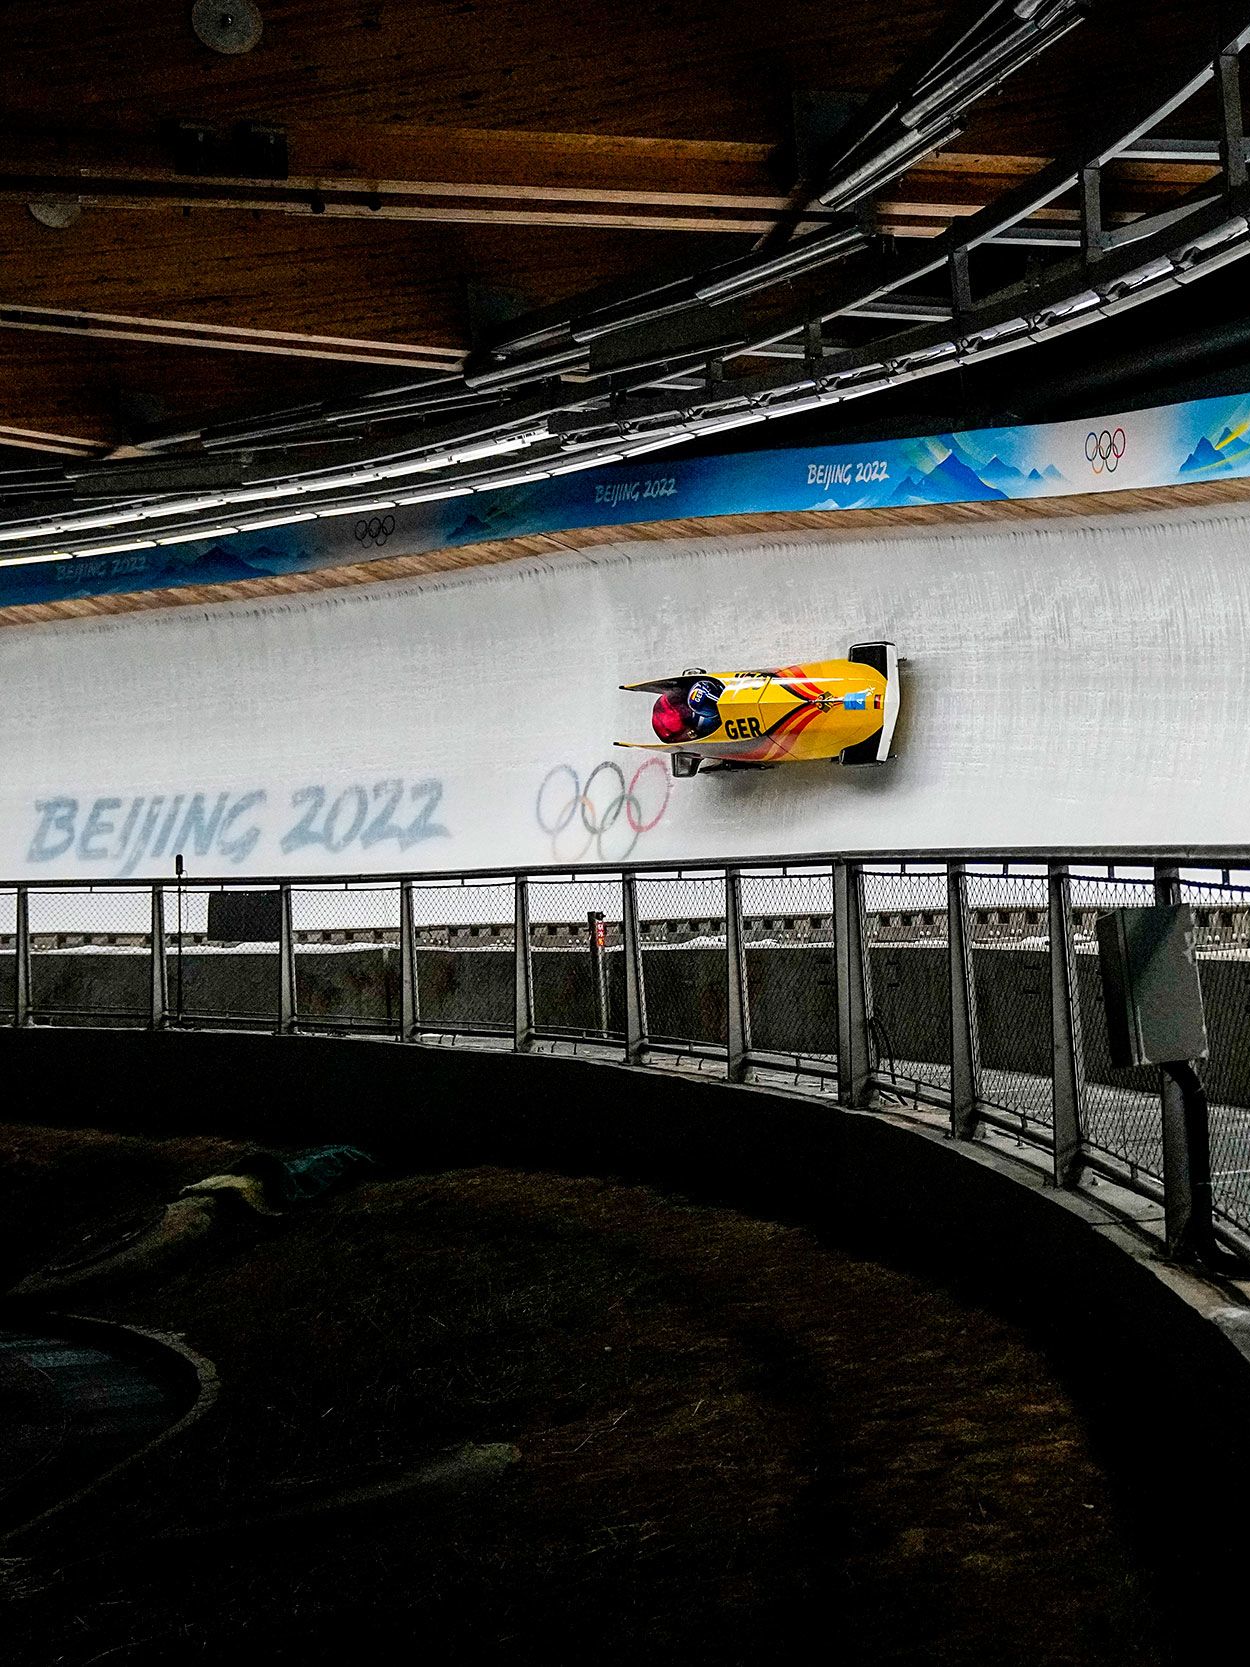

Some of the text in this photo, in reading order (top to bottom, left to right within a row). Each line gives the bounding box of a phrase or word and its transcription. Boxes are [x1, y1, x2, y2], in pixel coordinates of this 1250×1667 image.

[807, 460, 890, 491] BEIJING 2022
[594, 478, 678, 508] BEIJING 2022
[724, 717, 763, 740] GER
[25, 778, 453, 878] BEIJING 2022
